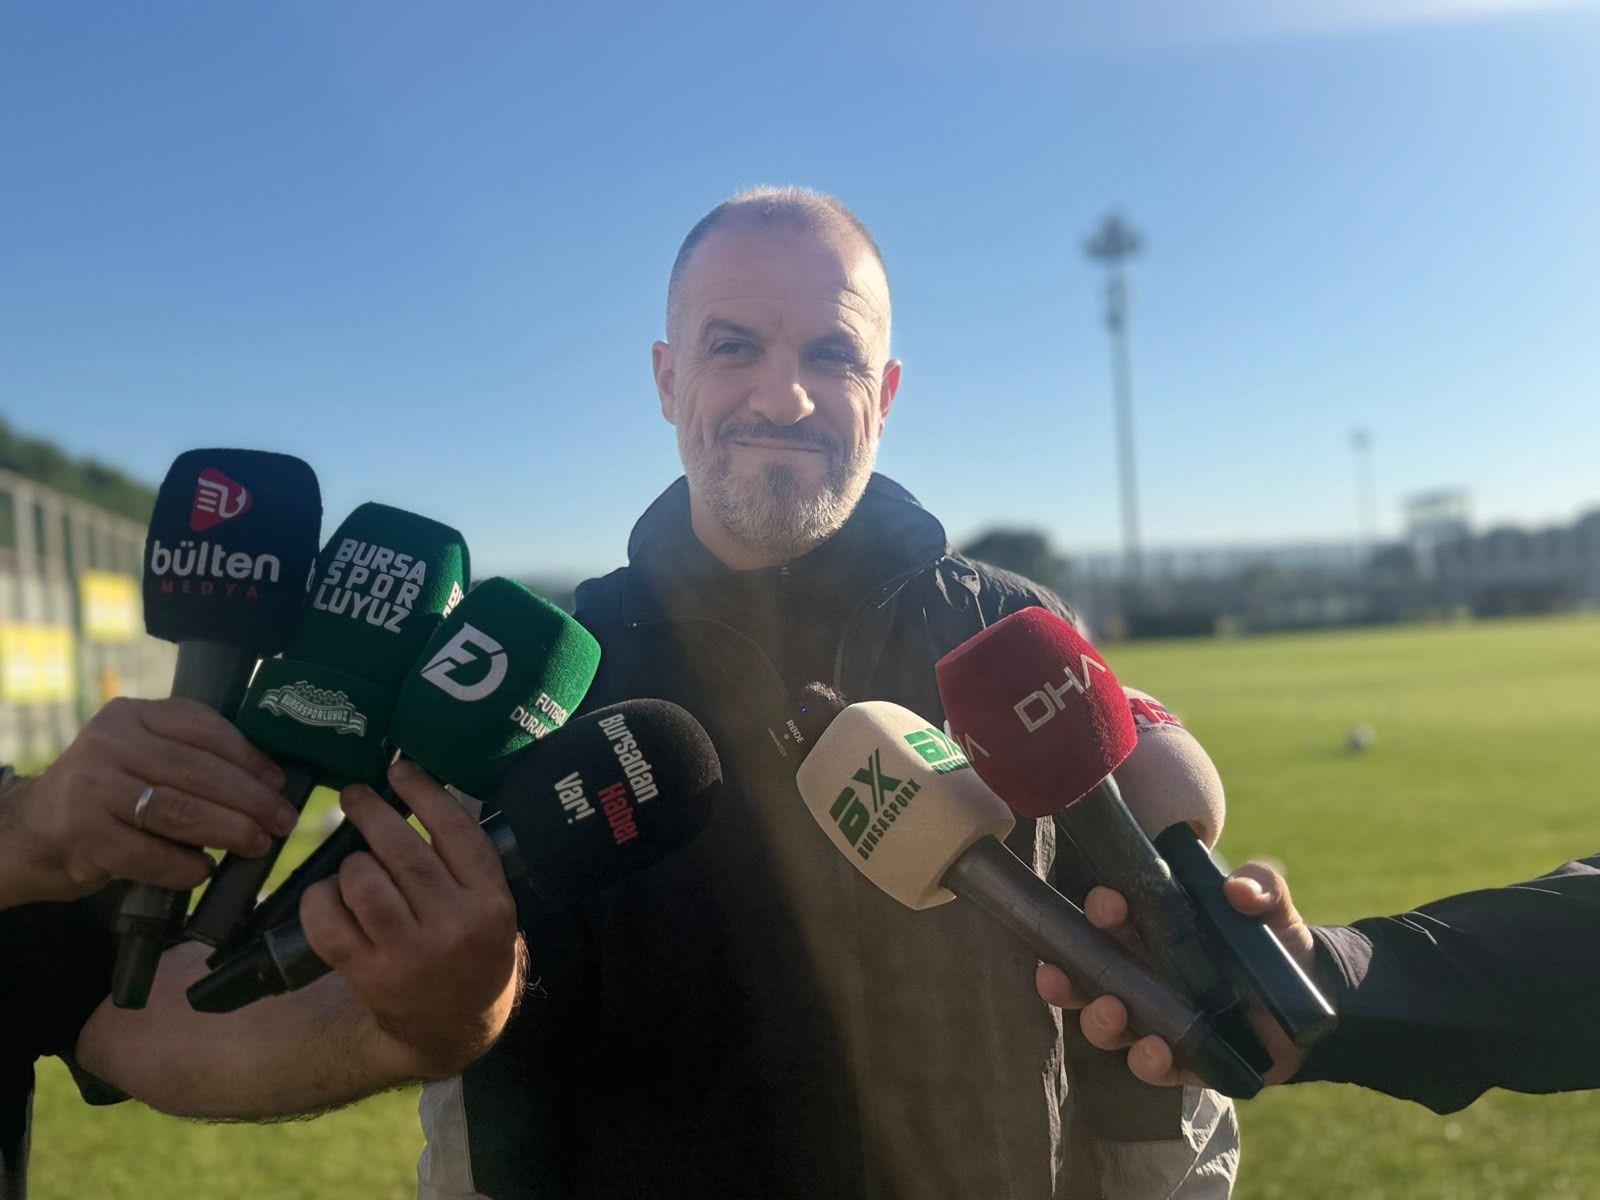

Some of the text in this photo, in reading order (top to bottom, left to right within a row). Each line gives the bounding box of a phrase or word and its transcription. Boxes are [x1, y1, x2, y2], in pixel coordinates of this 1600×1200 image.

[151, 541, 280, 583] bülten
[323, 561, 420, 609] SPOR
[335, 538, 426, 586] BURSA
[160, 580, 258, 599] MEDYA
[313, 584, 410, 633] LUYUZ
[1013, 654, 1106, 734] DHA
[598, 713, 659, 803] Bursadan
[554, 771, 595, 824] Var!
[598, 782, 639, 845] Haber
[857, 778, 921, 860] BURSASPORX
